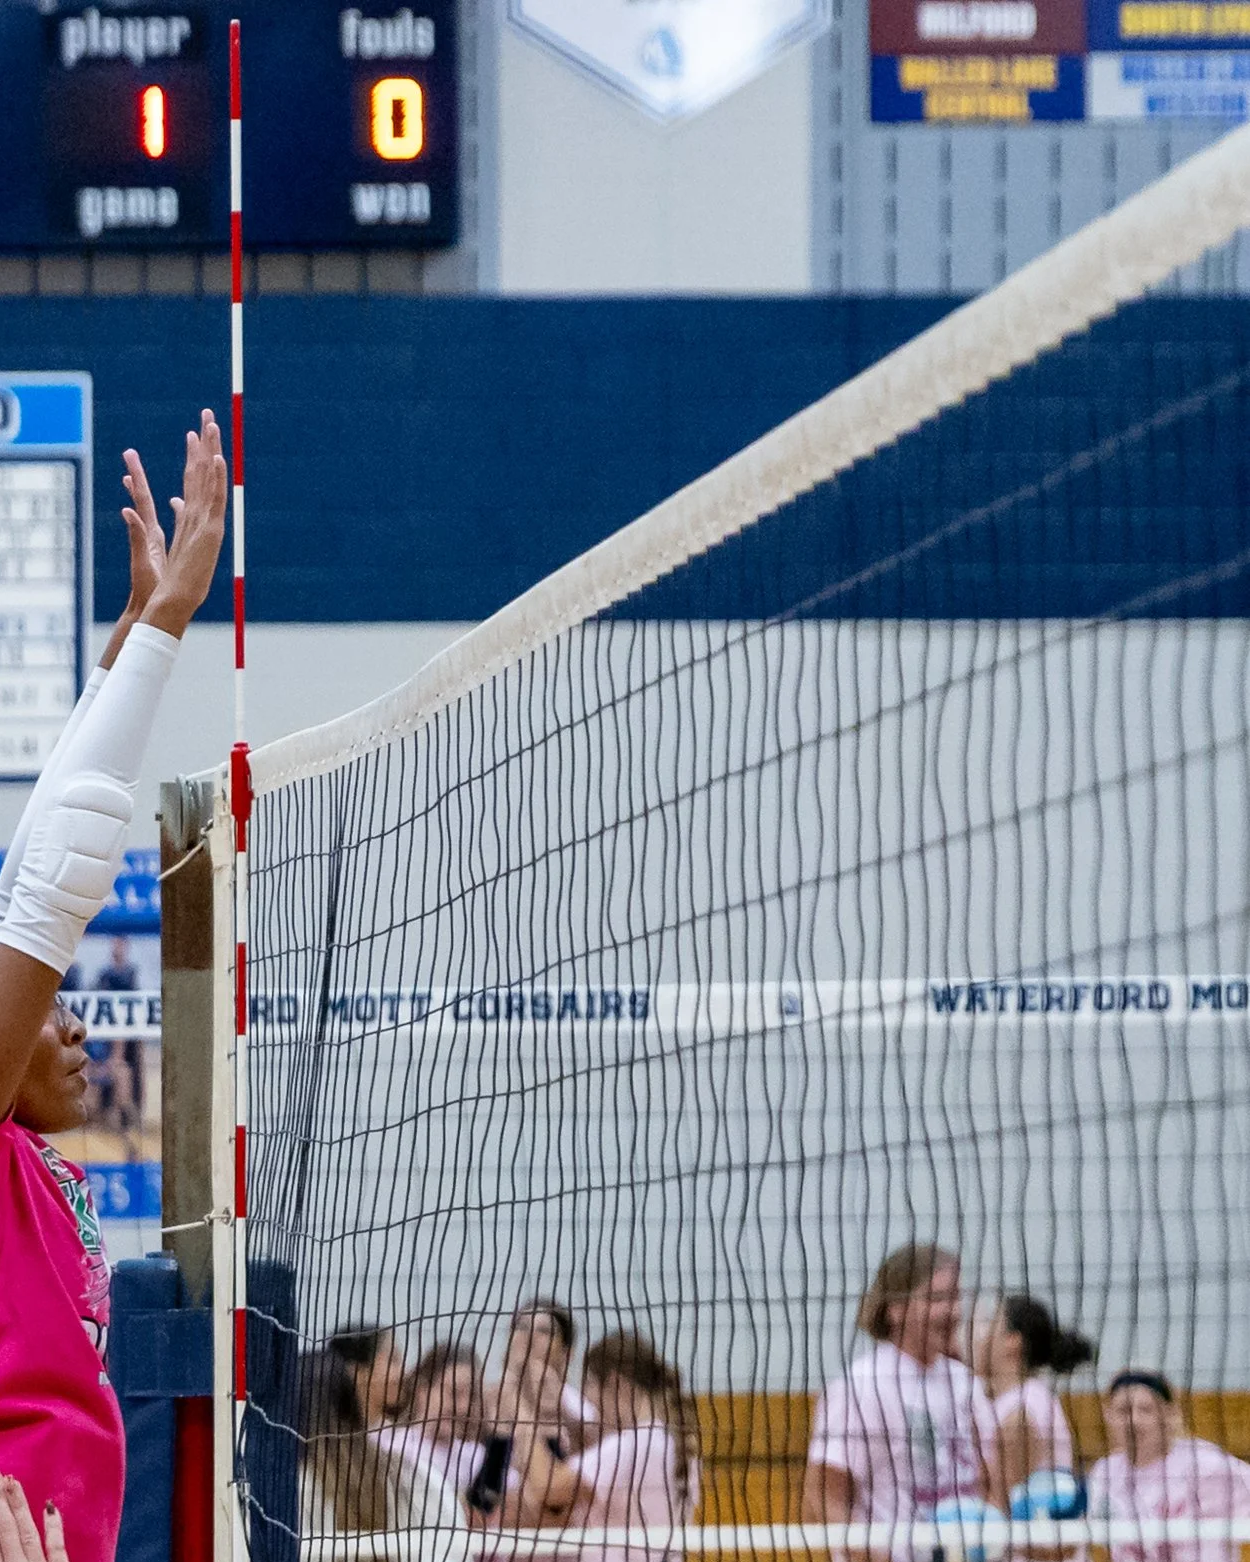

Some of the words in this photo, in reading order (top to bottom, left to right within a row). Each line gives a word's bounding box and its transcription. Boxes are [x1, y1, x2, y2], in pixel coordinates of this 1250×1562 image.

[61, 10, 192, 68] player
[342, 8, 436, 59] fouls
[141, 85, 166, 158] 1
[372, 78, 424, 160] 0
[77, 187, 179, 239] game
[352, 183, 431, 225] won
[327, 990, 429, 1023] MOTT
[452, 990, 649, 1021] CORSAIRS
[931, 982, 1172, 1013] WATERFORD
[1191, 982, 1248, 1011] MO
